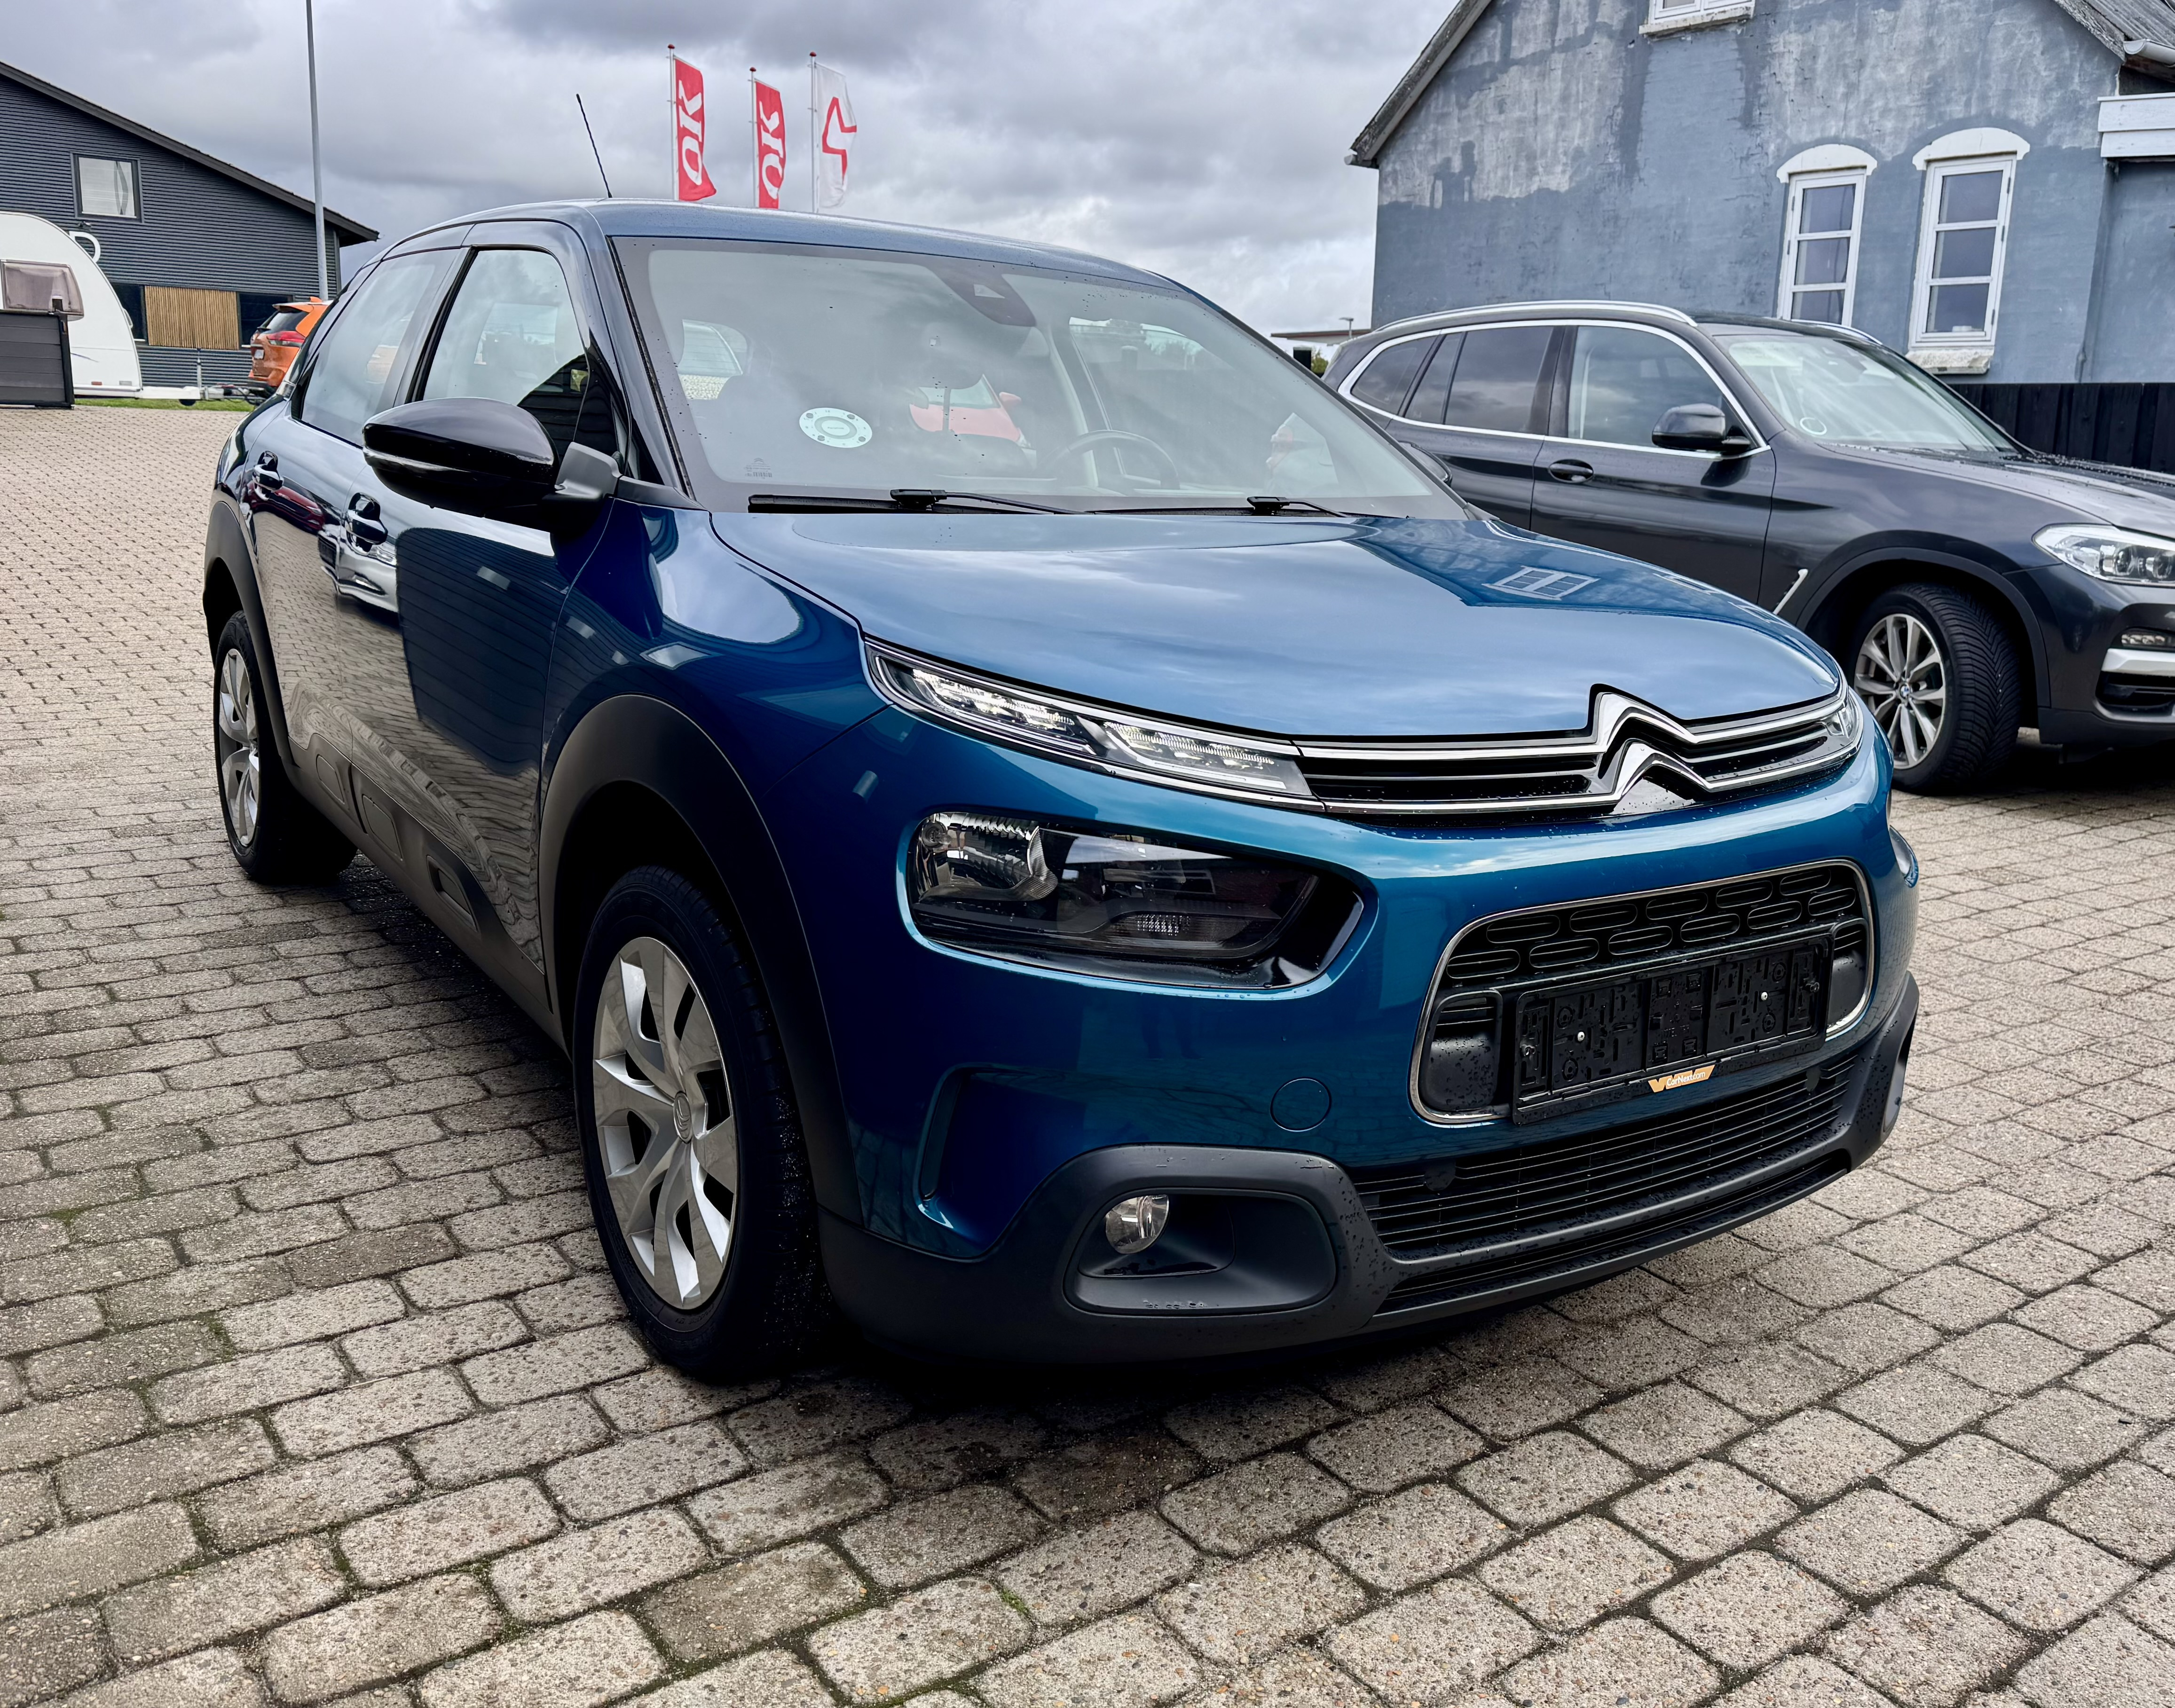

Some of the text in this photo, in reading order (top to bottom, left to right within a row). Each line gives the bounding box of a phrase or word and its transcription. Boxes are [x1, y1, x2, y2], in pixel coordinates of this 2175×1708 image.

[678, 79, 702, 186] OK
[759, 101, 784, 199] OK
[1666, 1071, 1706, 1086] CarNext.com
